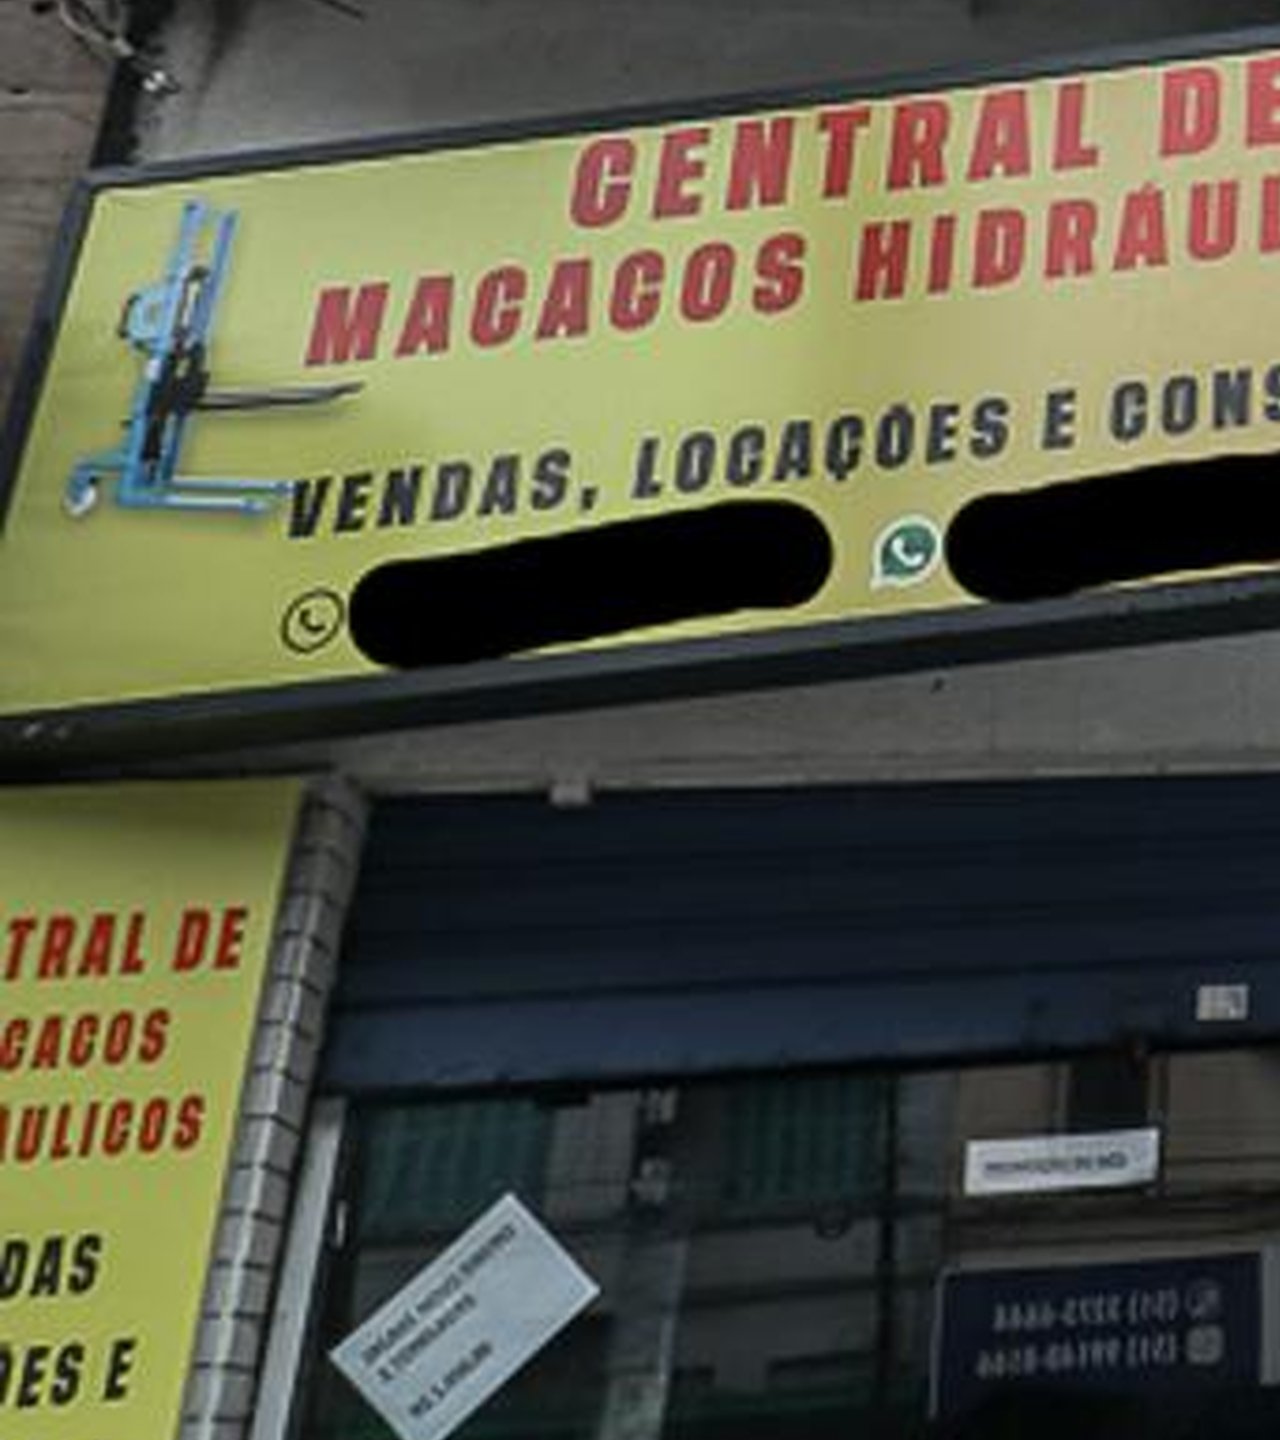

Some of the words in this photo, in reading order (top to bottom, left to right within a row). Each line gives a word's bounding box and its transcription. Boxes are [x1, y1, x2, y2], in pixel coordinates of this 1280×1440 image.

[570, 81, 1099, 229] CENTRAL
[303, 233, 806, 367] MACACOS
[287, 449, 597, 538] VENDAS,
[1041, 389, 1077, 450] E
[172, 907, 247, 972] DE
[104, 1338, 137, 1402] E
